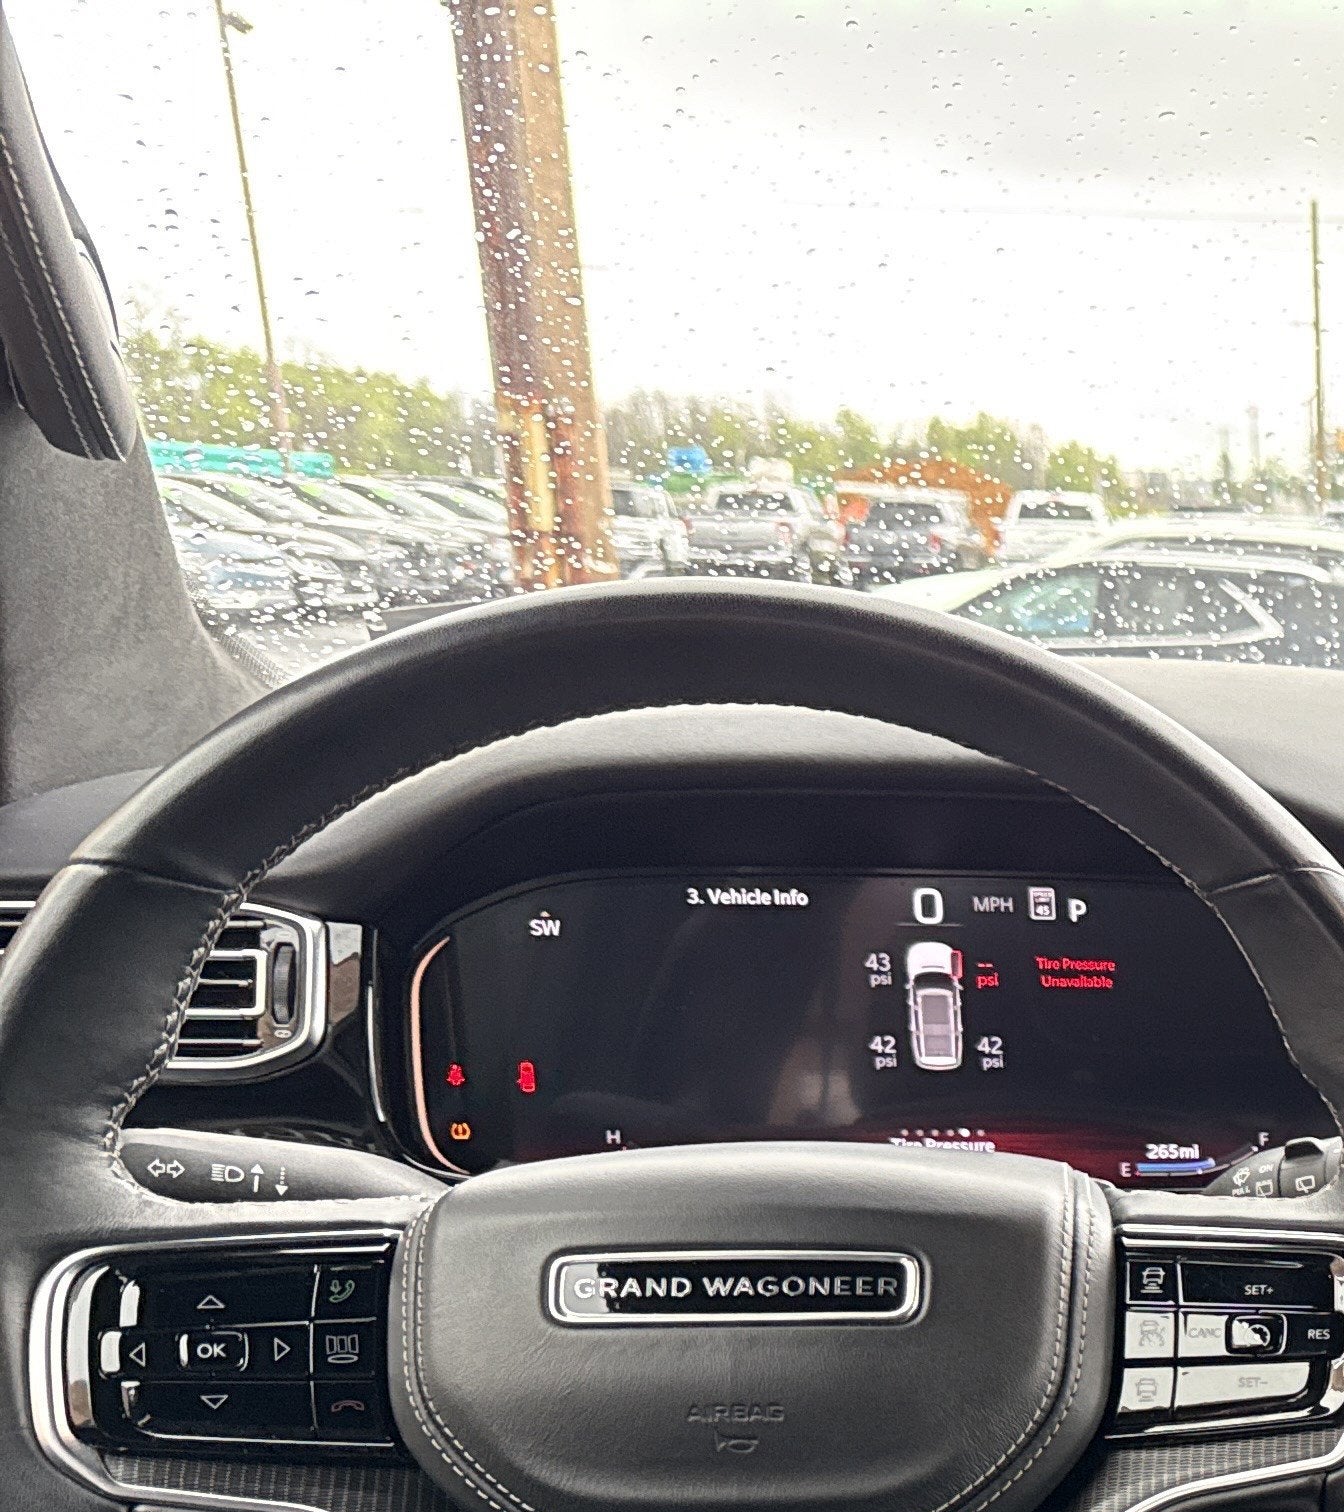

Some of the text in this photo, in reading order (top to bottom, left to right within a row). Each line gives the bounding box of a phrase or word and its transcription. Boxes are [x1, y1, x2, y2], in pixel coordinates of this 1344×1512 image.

[686, 888, 809, 906] 3. Vehicle Info
[913, 887, 943, 924] 0
[973, 896, 1014, 913] MPH
[1068, 898, 1087, 922] P
[529, 919, 561, 936] SW
[864, 953, 891, 972] 43
[1035, 957, 1116, 972] Tire Pressure
[870, 973, 892, 987] psi
[976, 972, 999, 989] psi
[1040, 975, 1113, 989] Unavailable
[869, 1035, 897, 1054] 42
[976, 1036, 1003, 1055] 42
[874, 1055, 897, 1070] psi
[981, 1055, 1004, 1071] psi
[606, 1129, 621, 1145] H
[1258, 1132, 1269, 1146] F
[1120, 1162, 1131, 1178] E
[574, 1276, 899, 1299] GRAND WAGONEER
[1307, 1328, 1331, 1340] RES
[196, 1343, 227, 1359] OK
[687, 1403, 784, 1422] AIRBAG
